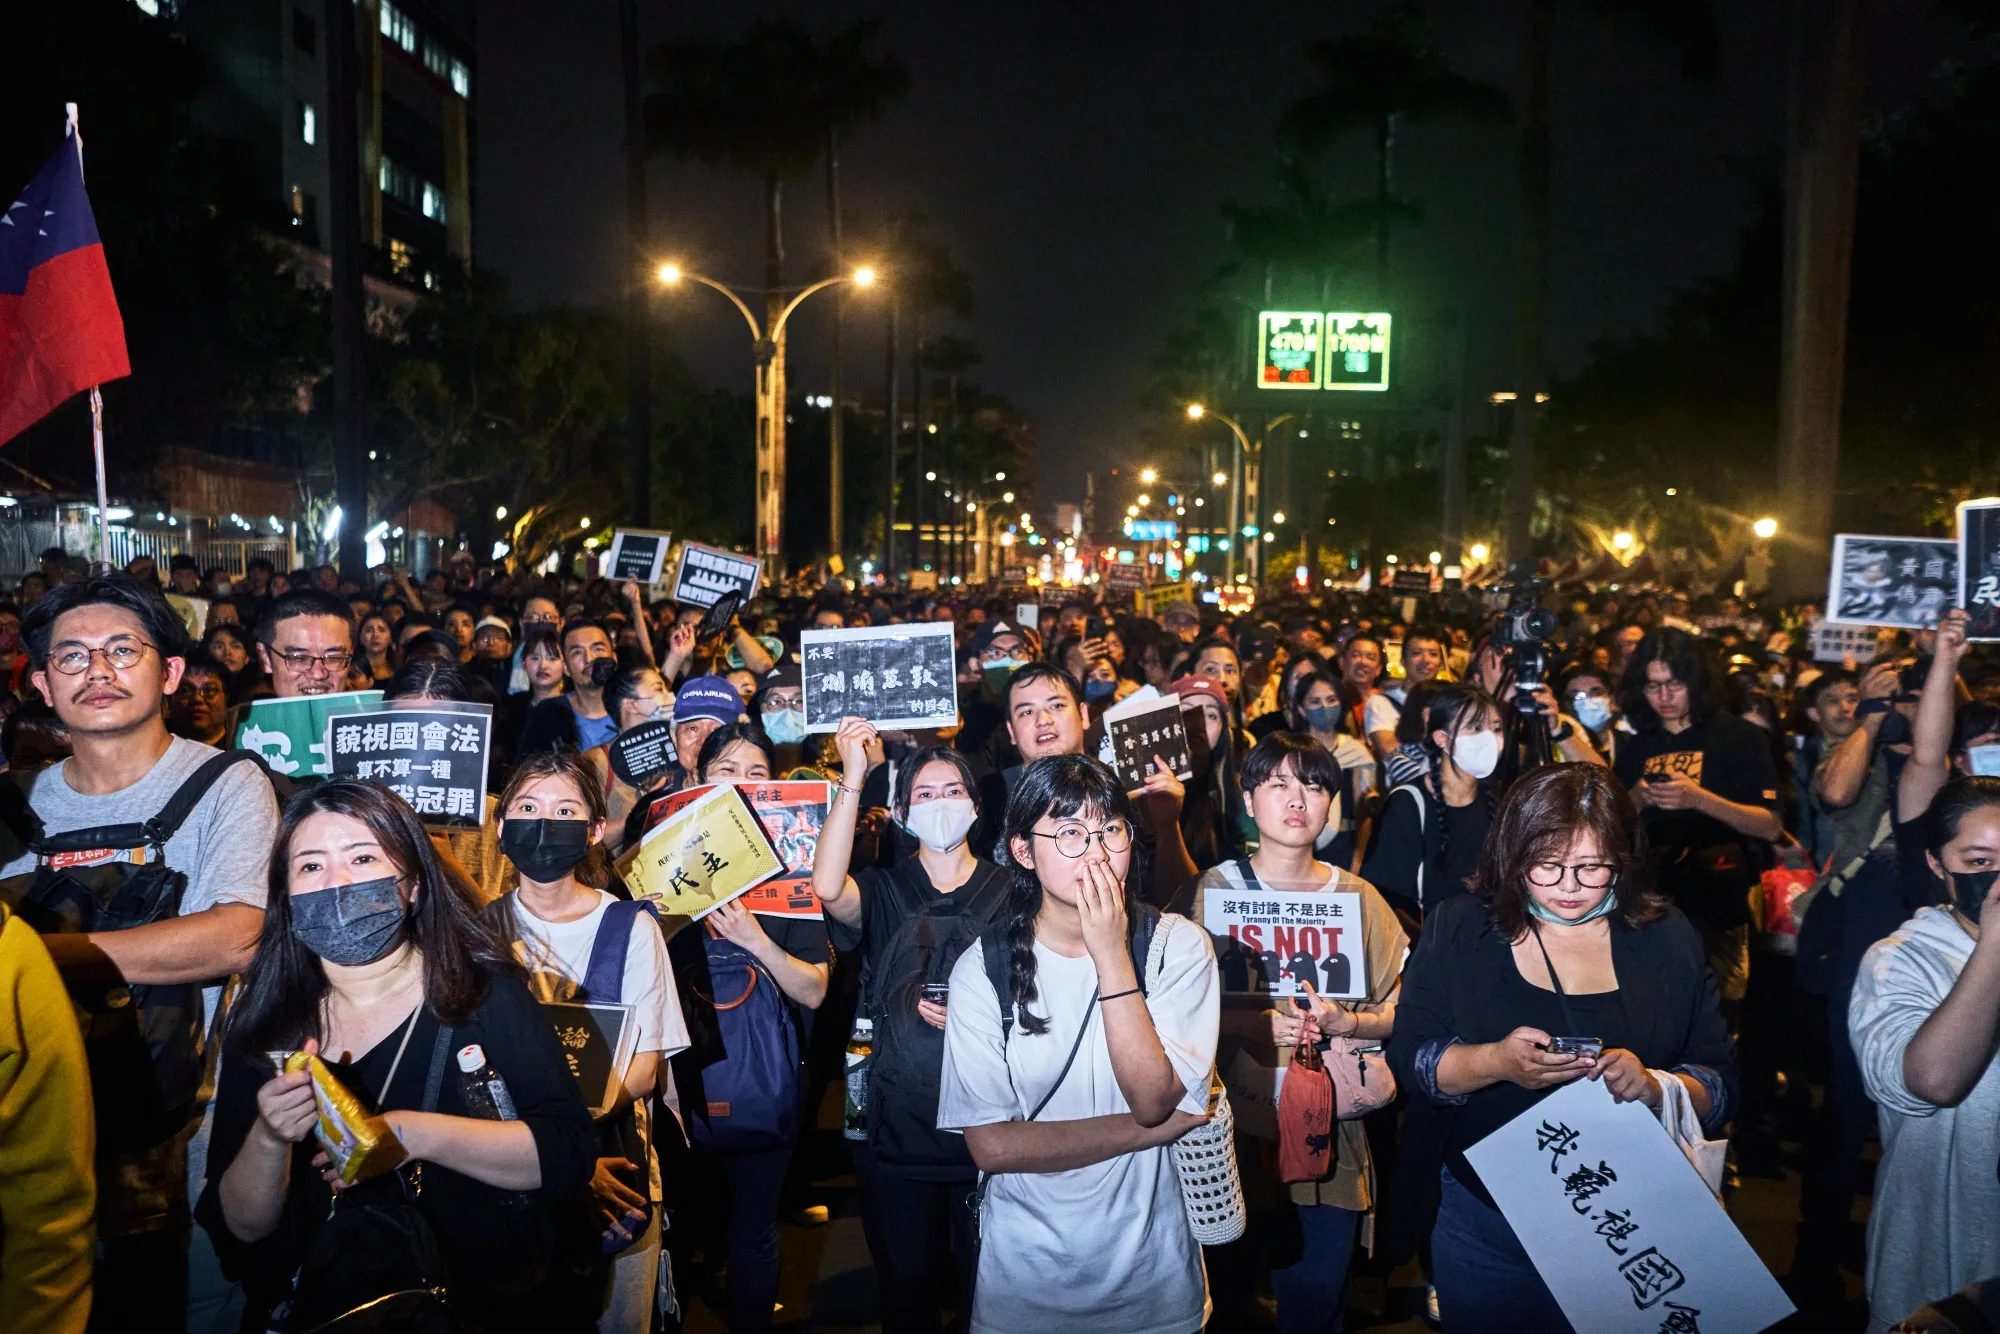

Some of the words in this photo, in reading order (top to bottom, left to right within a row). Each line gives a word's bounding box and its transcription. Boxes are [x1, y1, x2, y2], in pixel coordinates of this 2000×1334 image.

[808, 646, 834, 661] 不要
[682, 690, 704, 699] CHINA
[704, 690, 733, 702] AIRLINES
[336, 721, 480, 754] 藐視國會法
[356, 758, 452, 780] 算不算一種
[669, 851, 729, 896] 民主
[1223, 900, 1281, 915] 沒有討論
[1285, 902, 1343, 917] 不是民主
[1242, 915, 1271, 925] Tyranny
[1296, 917, 1326, 926] Majority
[1228, 924, 1263, 957] IS
[1274, 925, 1343, 961] NOT
